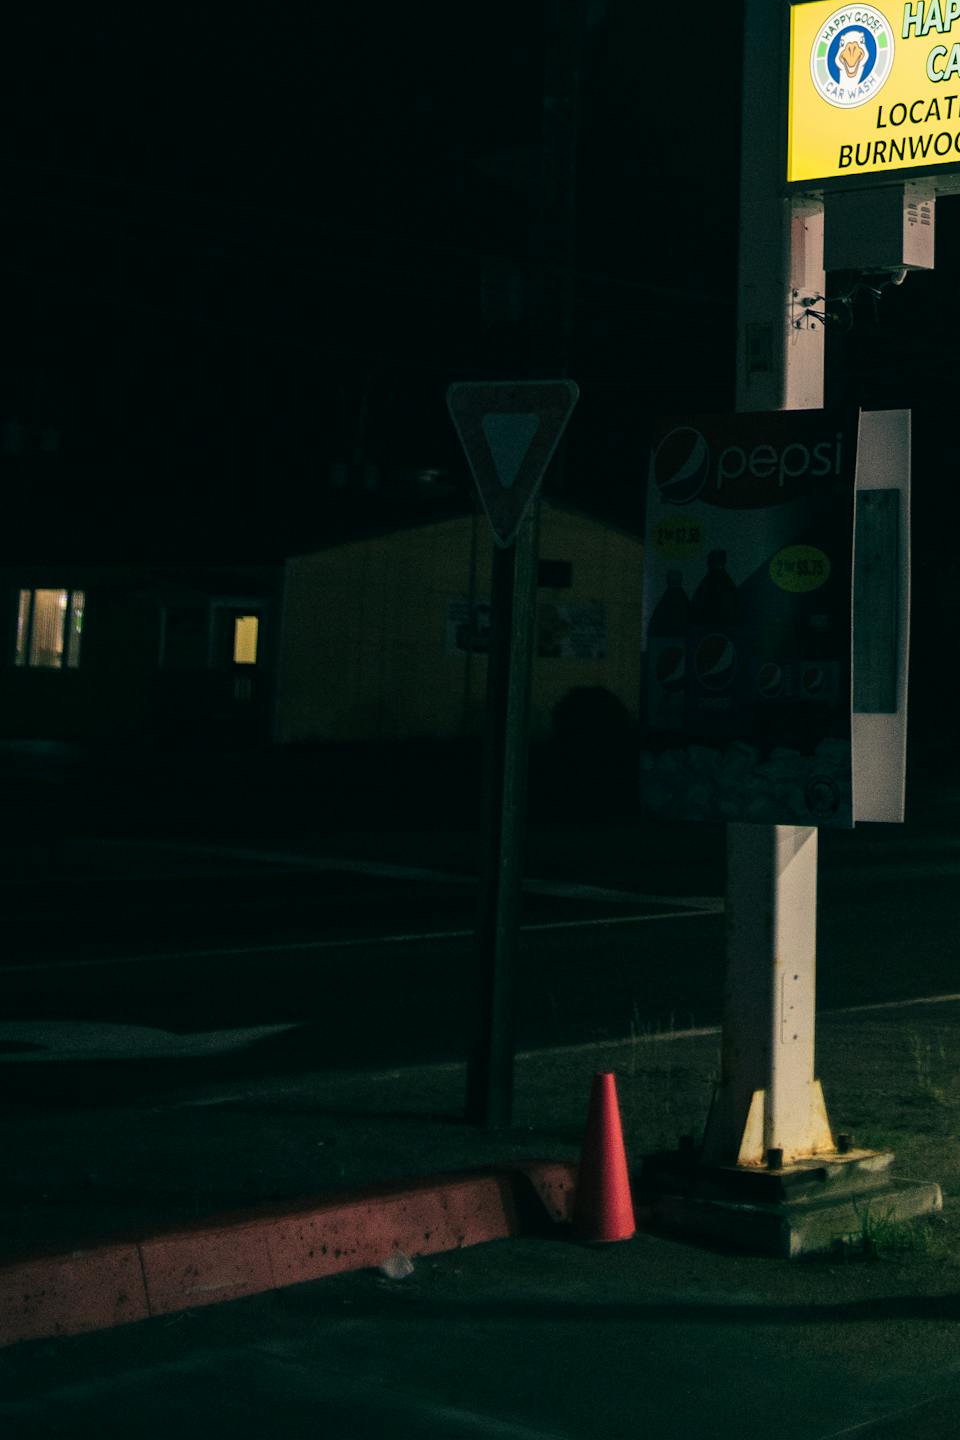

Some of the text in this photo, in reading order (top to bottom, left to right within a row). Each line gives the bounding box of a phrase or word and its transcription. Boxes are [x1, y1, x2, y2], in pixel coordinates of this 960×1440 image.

[822, 11, 883, 40] HAPPY GOOSE
[826, 77, 876, 99] CAR WASH
[716, 431, 844, 490] pepsi
